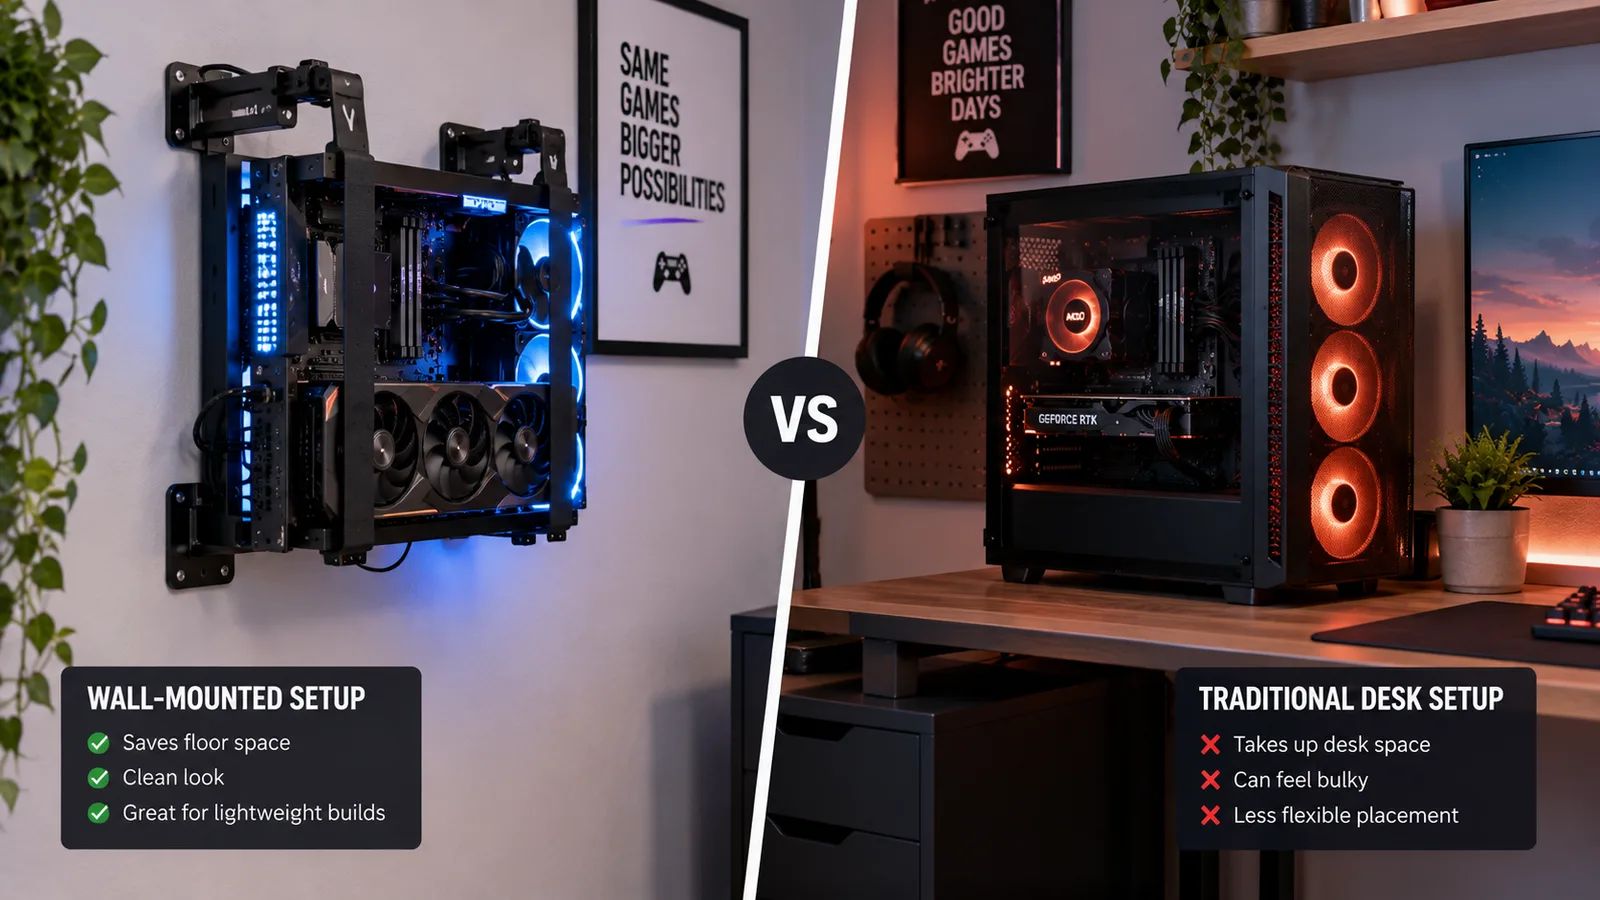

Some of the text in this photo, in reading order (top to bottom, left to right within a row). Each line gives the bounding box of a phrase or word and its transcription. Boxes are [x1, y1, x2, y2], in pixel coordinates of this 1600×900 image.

[948, 5, 1005, 35] GOOD
[620, 41, 669, 87] SAME
[942, 35, 1012, 66] GAMES
[931, 64, 1025, 96] BRIGHTER
[620, 82, 680, 128] GAMES
[951, 94, 1001, 122] DAYS
[620, 122, 681, 167] BIGGER
[620, 163, 725, 213] POSSIBILITIES
[1038, 413, 1098, 425] GEFORCE RTK
